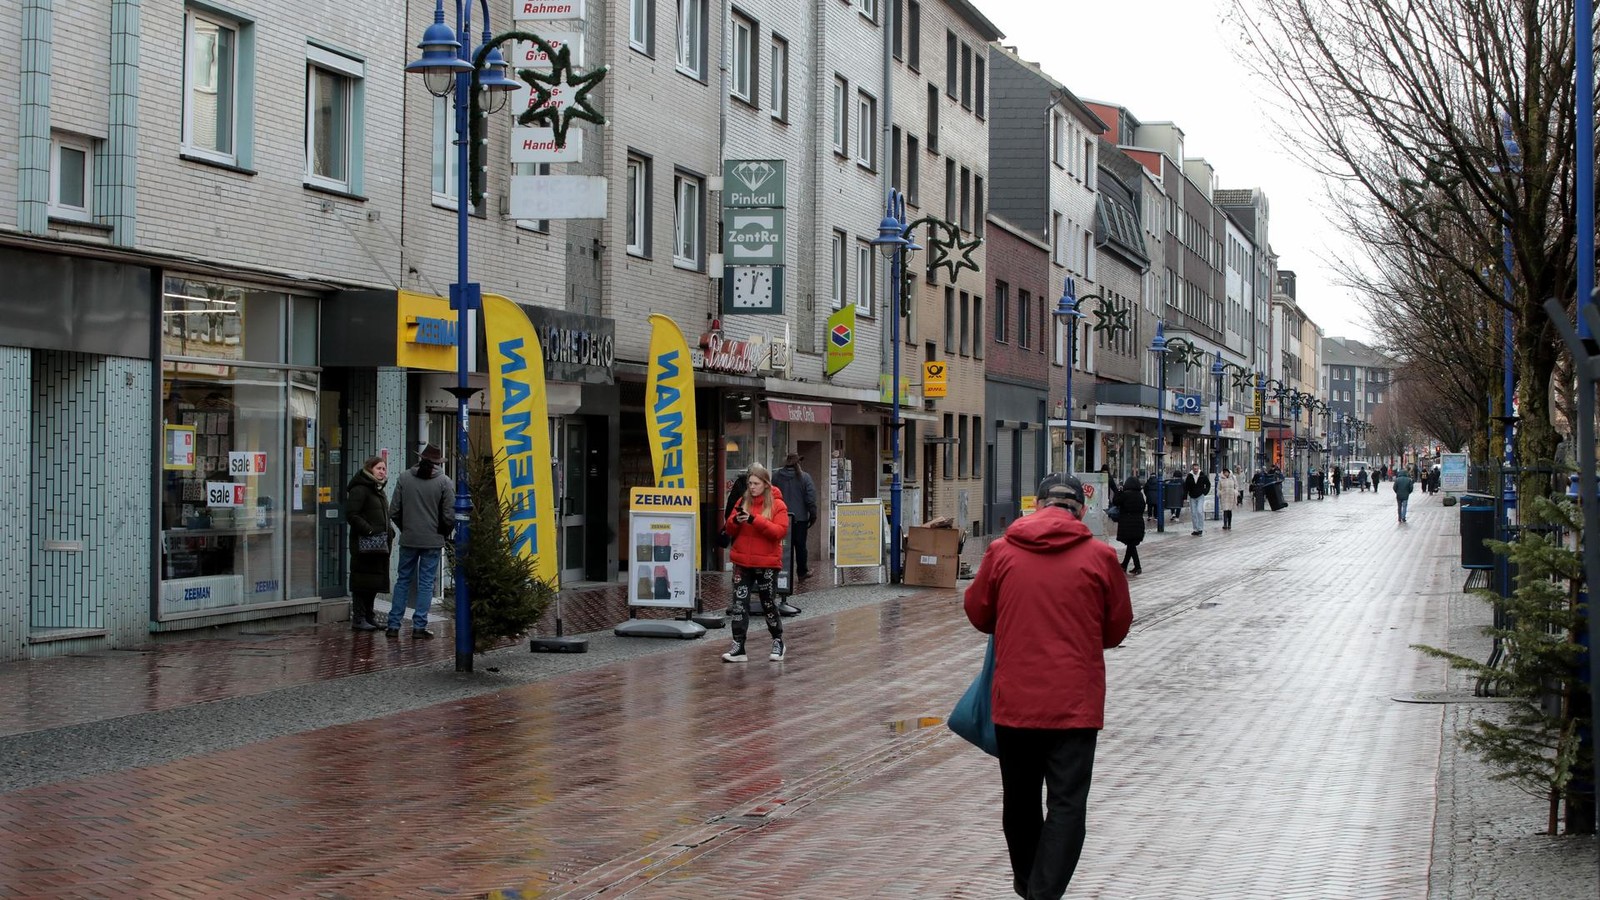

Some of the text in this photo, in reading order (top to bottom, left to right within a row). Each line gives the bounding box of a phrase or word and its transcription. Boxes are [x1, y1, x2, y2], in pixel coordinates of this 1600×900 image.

[523, 3, 571, 14] Rahmen
[731, 192, 775, 205] Pinkall
[728, 230, 779, 242] ZentRa
[231, 454, 250, 473] sale
[209, 485, 230, 503] sale
[635, 494, 692, 506] ZEEMAN
[184, 586, 211, 600] ZEEMAN
[255, 580, 279, 593] ZEEMAN
